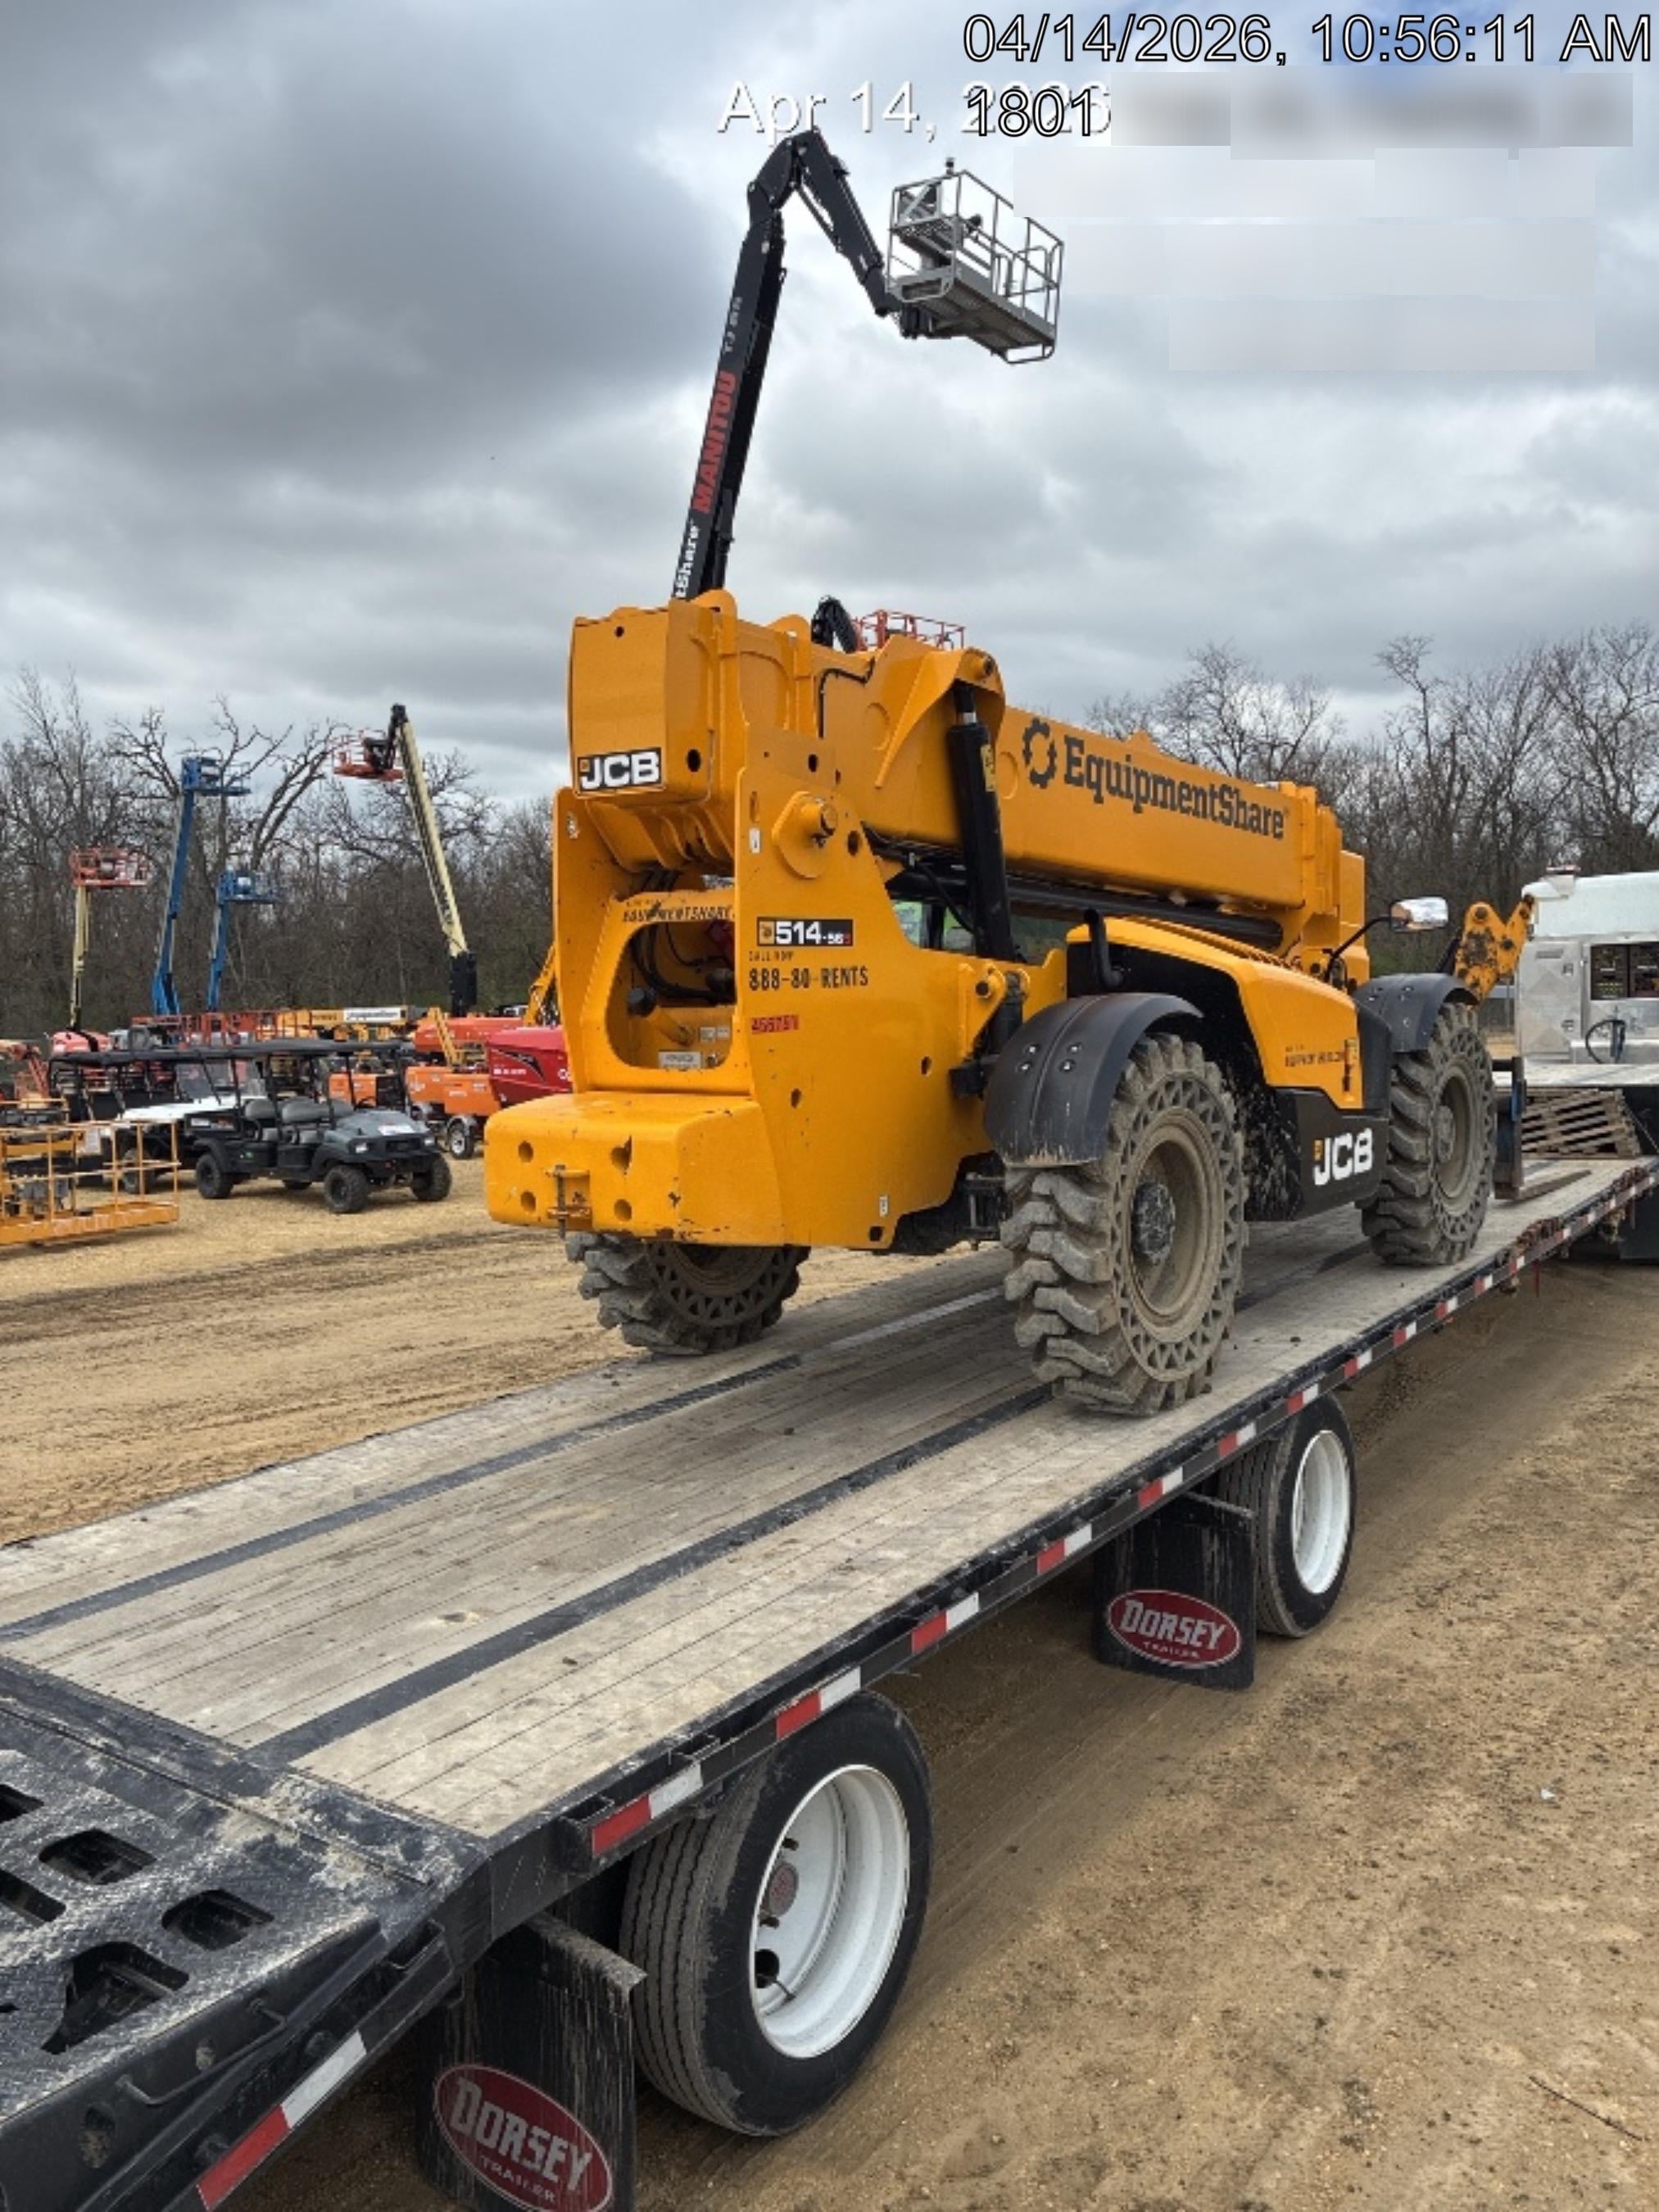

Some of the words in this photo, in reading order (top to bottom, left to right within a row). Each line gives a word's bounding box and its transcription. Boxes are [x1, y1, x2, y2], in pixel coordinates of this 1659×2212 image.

[691, 369, 737, 514] MANITOU
[581, 751, 660, 790] JCB
[1063, 733, 1285, 840] EquipmentShare
[1313, 1127, 1373, 1185] JCB
[1118, 1598, 1227, 1651] DORSEY
[1142, 1640, 1200, 1660] TRAILER
[451, 2076, 593, 2192] DORSEY
[479, 2155, 556, 2203] TRAILER
